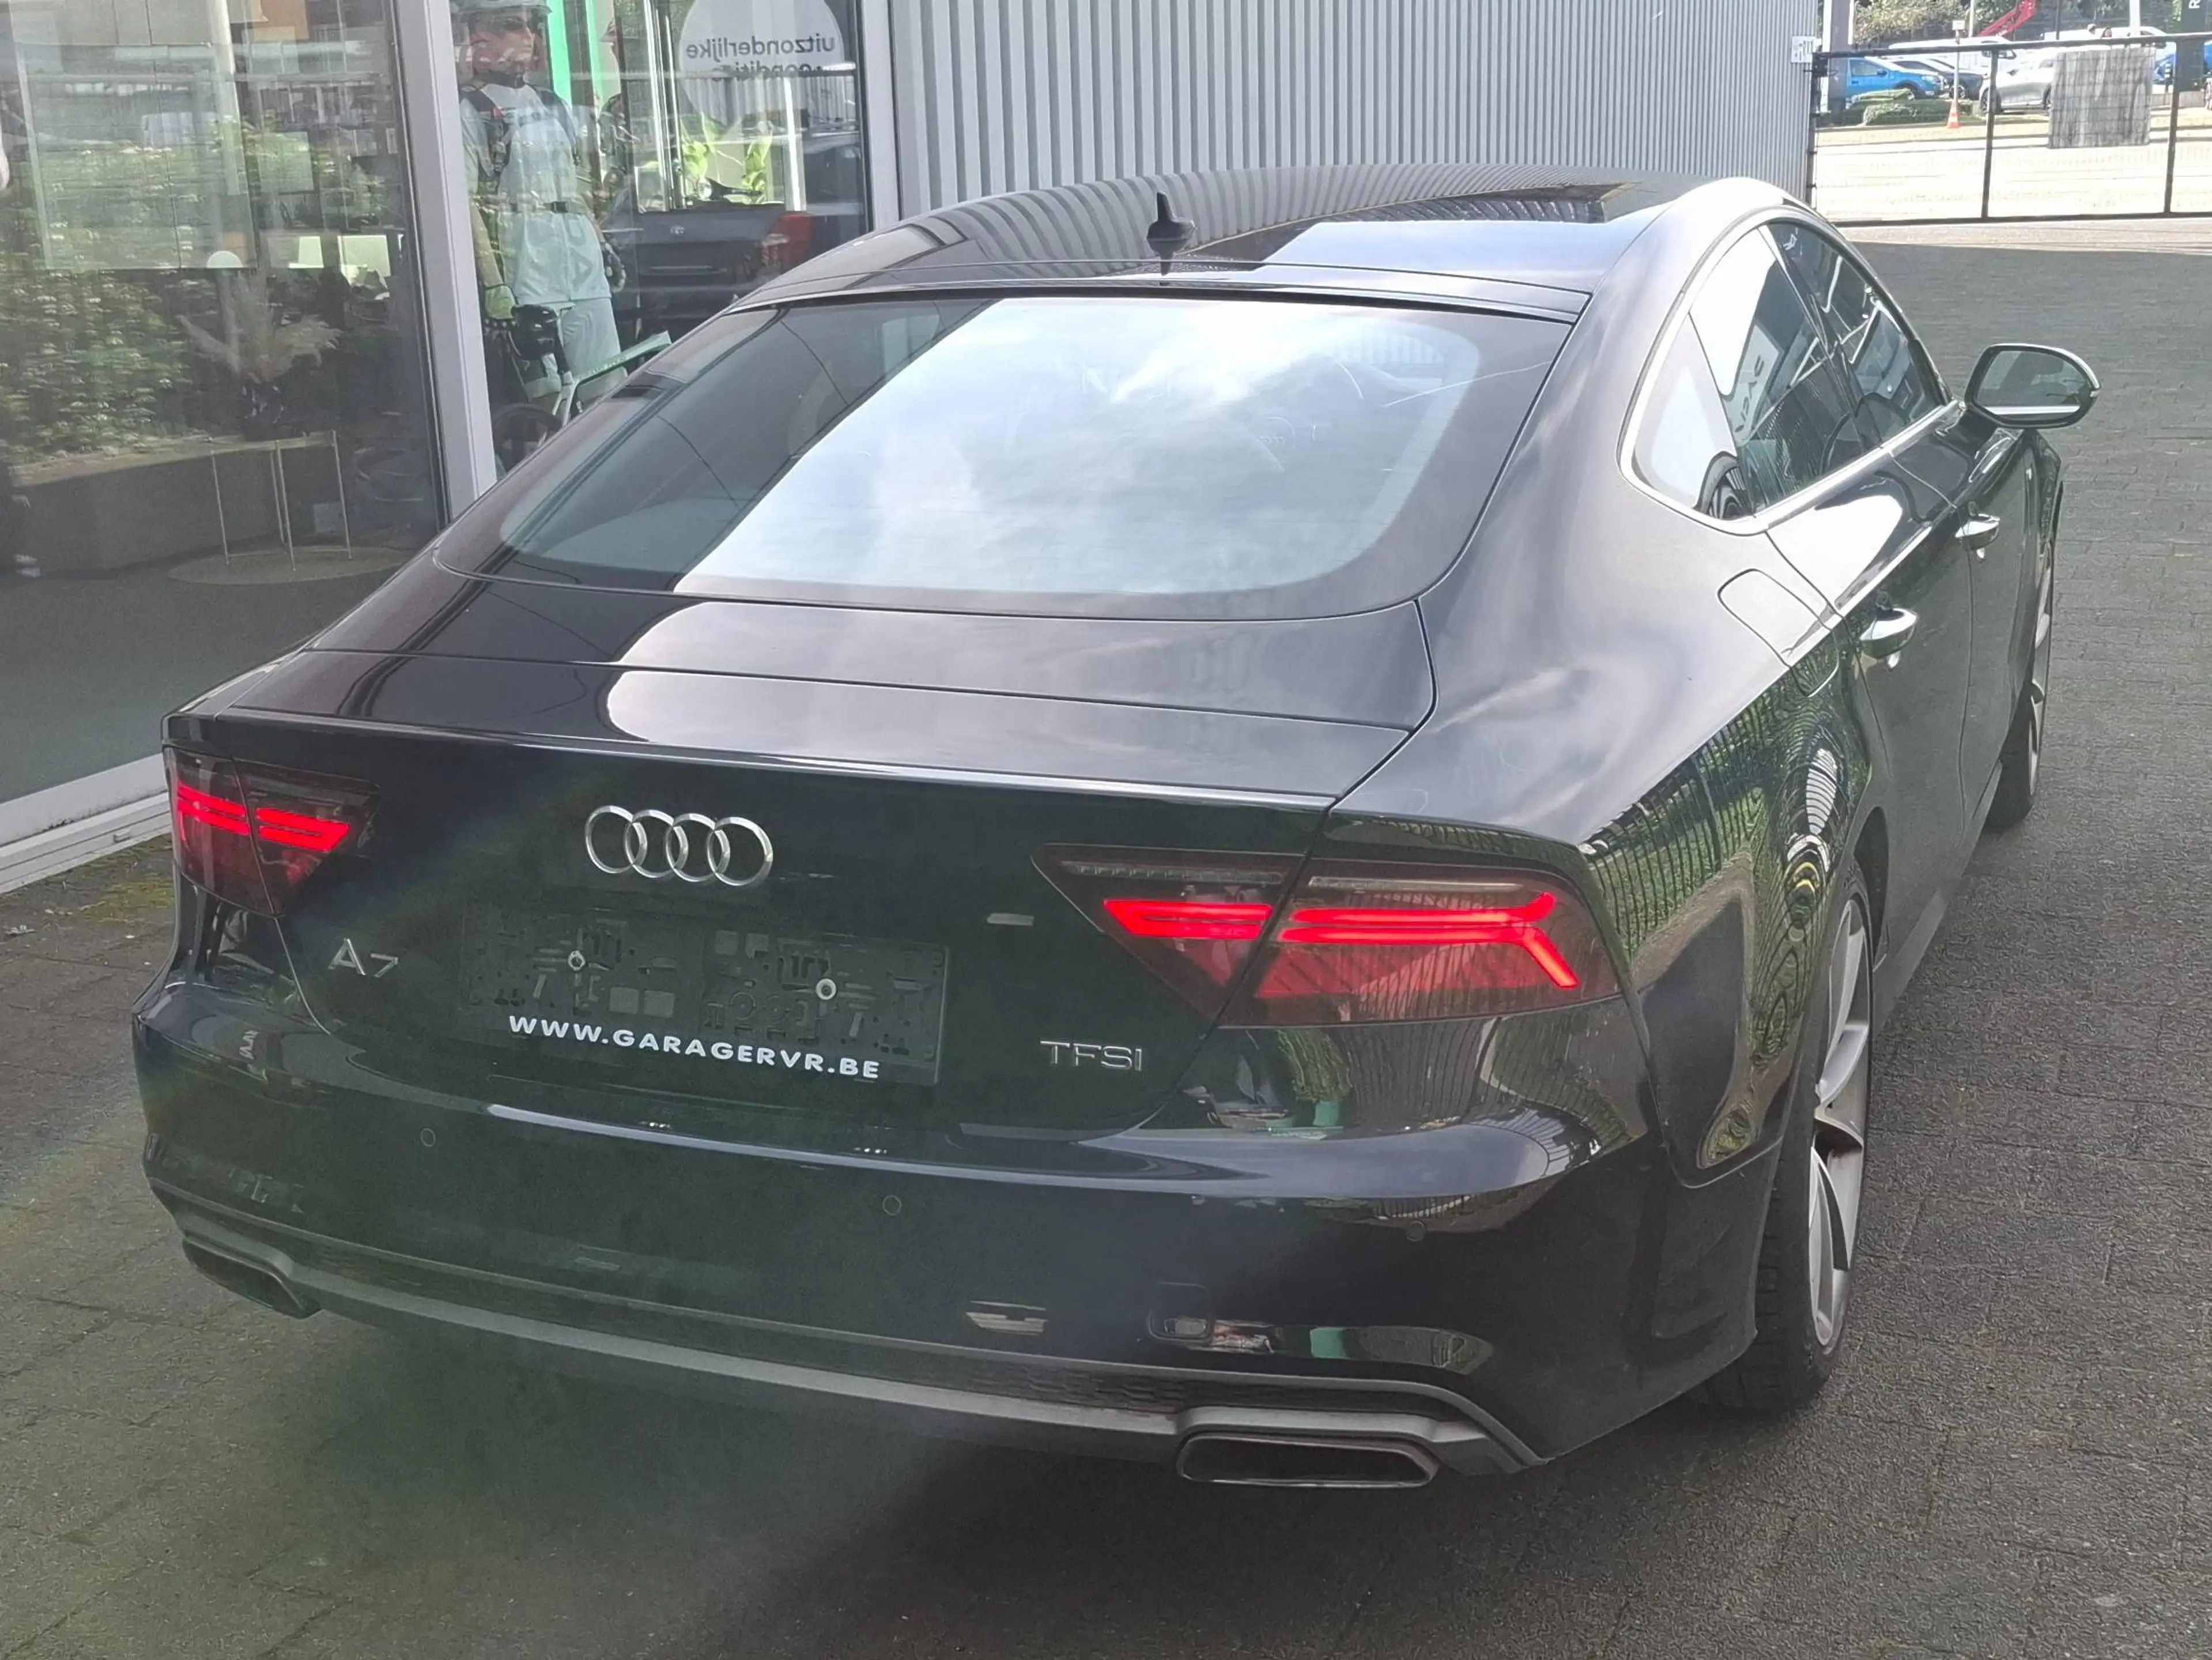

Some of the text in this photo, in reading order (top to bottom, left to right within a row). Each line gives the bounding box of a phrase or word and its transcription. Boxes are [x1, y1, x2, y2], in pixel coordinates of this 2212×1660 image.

[327, 938, 399, 978] A7
[509, 1015, 879, 1079] WWW.GARAGERVR.BE
[1040, 1040, 1142, 1071] TFSI
